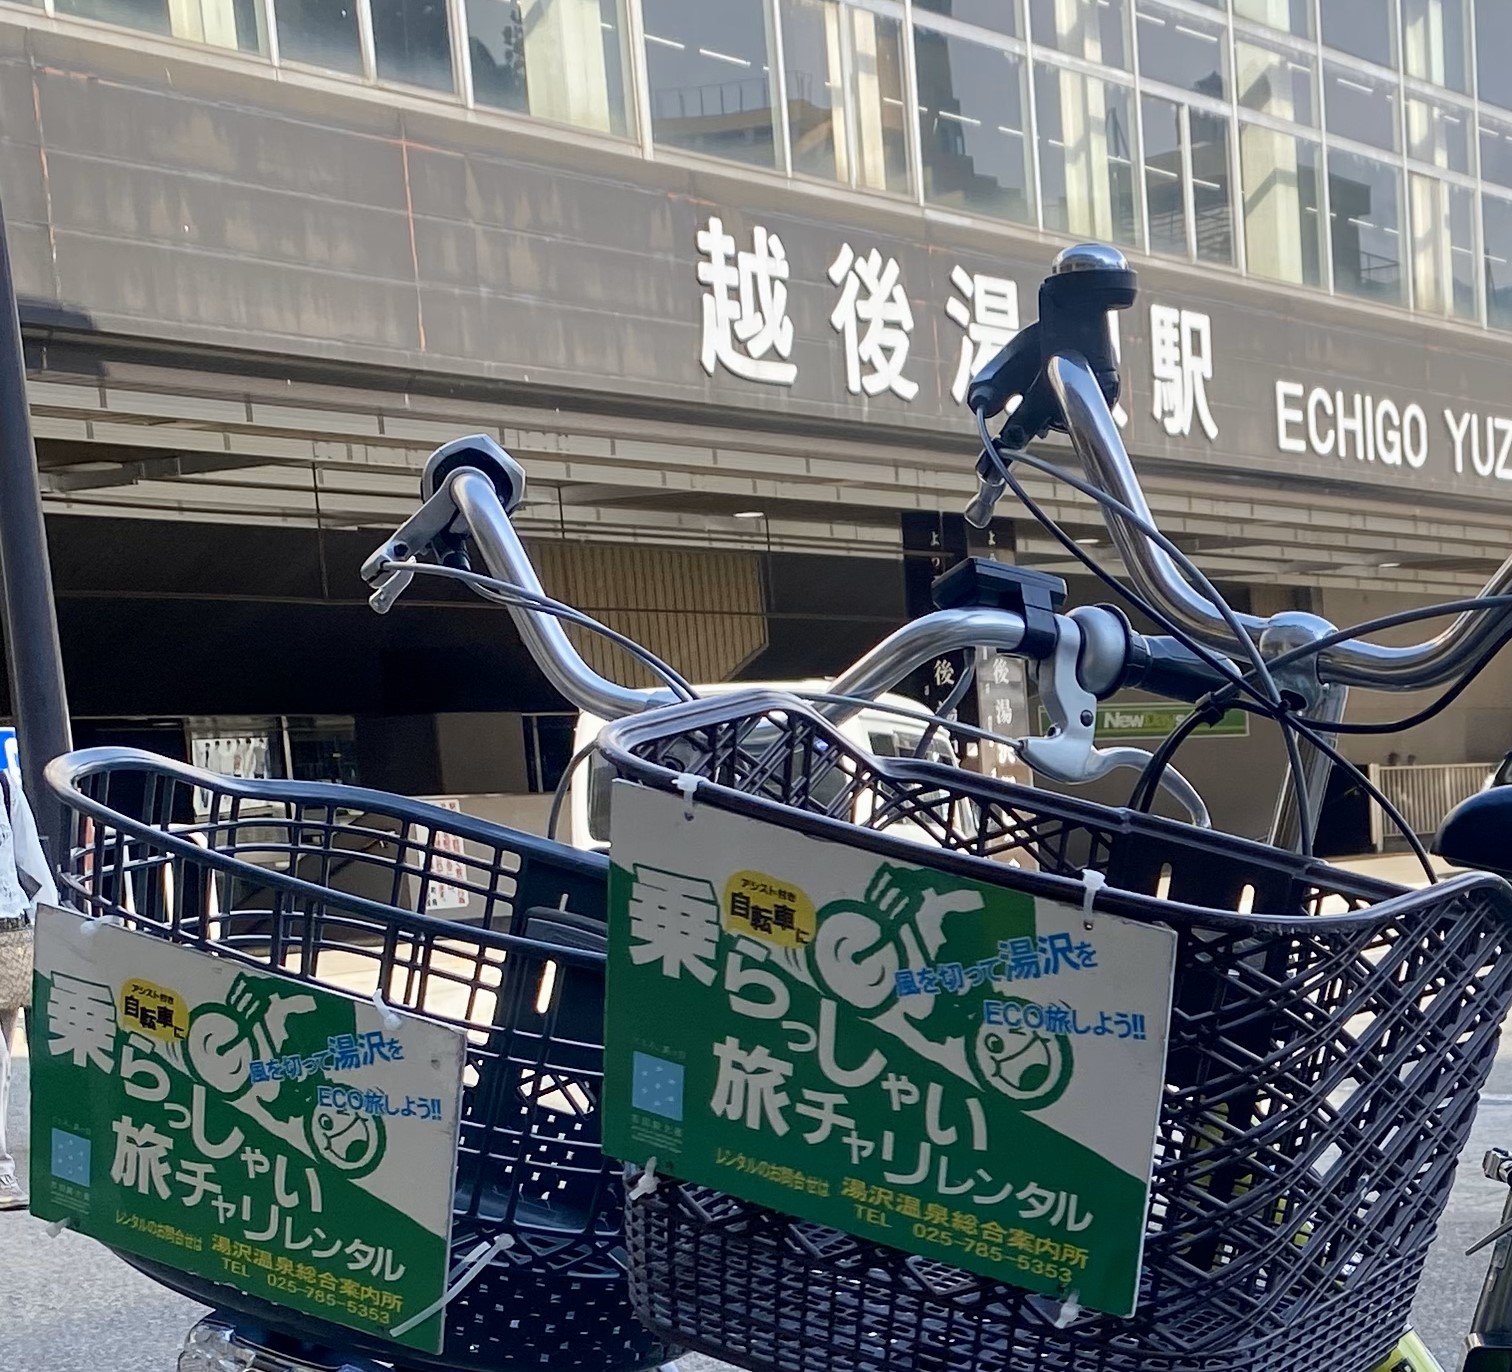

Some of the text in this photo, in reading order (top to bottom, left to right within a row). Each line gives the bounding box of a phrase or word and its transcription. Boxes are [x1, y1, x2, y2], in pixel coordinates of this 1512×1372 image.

[697, 216, 1218, 440] 越後湯駅
[1275, 380, 1429, 467] ECHIGO
[731, 892, 809, 944] 自転車に
[895, 932, 1098, 998] 風を切って湯沢を
[124, 995, 185, 1039] 自転車に
[629, 868, 988, 1151] 乗らっしゃい
[48, 972, 325, 1213] 乗らっしゃい
[249, 1031, 405, 1084] 風を切って湯沢を
[711, 1036, 1093, 1233] 旅チャリレンタル
[110, 1116, 406, 1282] 旅チャリレンタル
[840, 1176, 1089, 1269] 湯沢温泉総合案内所
[210, 1233, 404, 1313] 湯沢温泉総合案内所
[854, 1203, 1073, 1283] TEL 025-785-5353
[222, 1257, 391, 1325] TEL 025-785-5353
